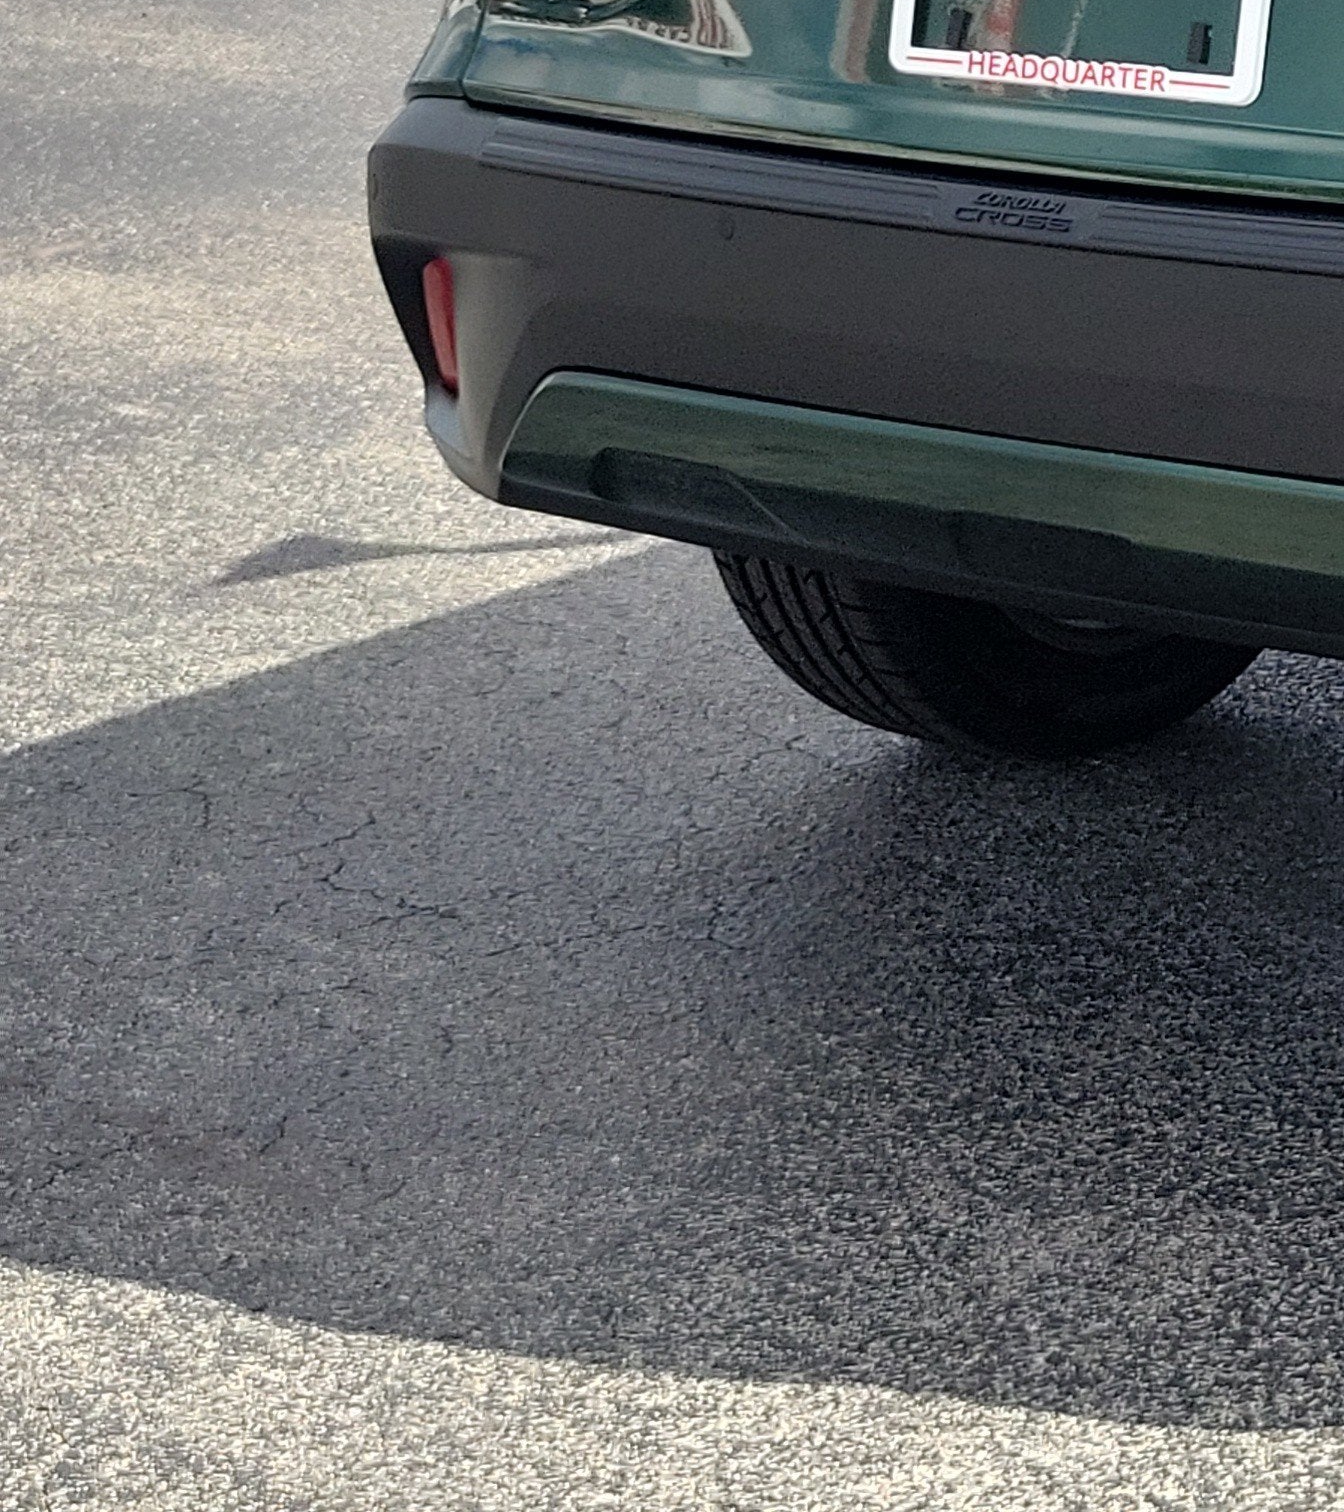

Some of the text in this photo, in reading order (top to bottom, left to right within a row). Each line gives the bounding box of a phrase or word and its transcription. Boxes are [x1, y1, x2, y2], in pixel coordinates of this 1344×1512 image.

[967, 52, 1166, 93] HEADQUARTER
[973, 190, 1067, 215] COROLLA
[954, 206, 1074, 233] CROSS
